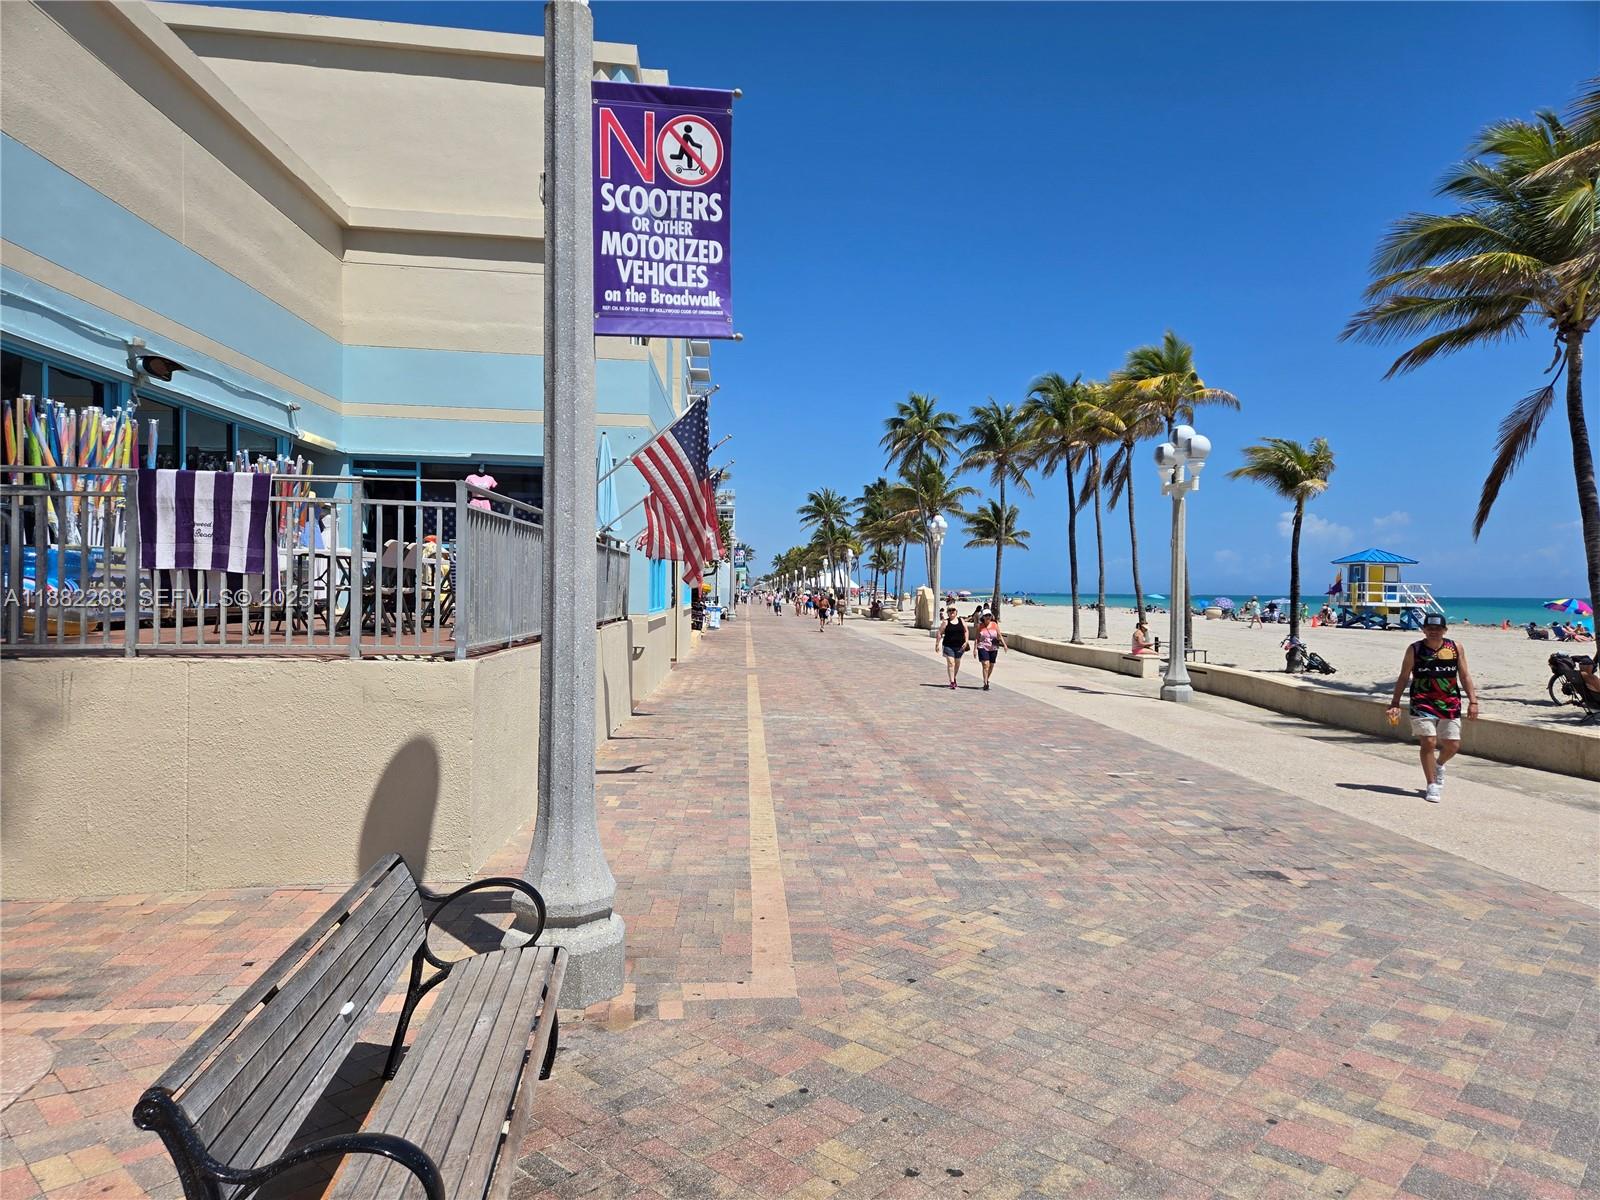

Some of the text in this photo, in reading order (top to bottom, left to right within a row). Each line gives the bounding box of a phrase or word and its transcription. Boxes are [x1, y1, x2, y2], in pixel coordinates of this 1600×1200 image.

[600, 183, 723, 222] SCOOTERS
[632, 216, 693, 236] OR OTHER
[601, 231, 723, 264] MOTORIZED
[616, 259, 709, 288] VEHICLES
[604, 286, 721, 307] on the Broadwalk
